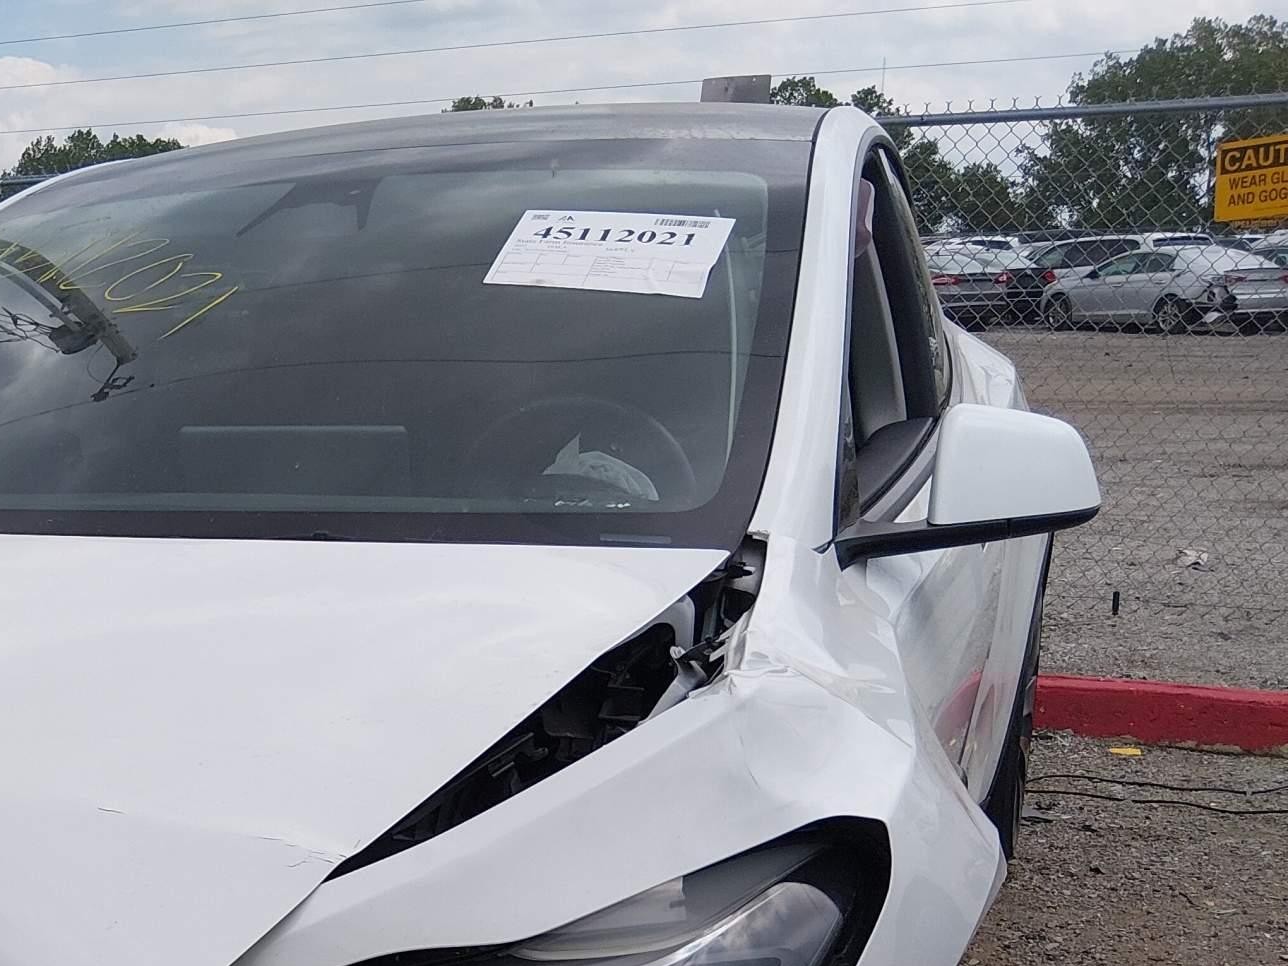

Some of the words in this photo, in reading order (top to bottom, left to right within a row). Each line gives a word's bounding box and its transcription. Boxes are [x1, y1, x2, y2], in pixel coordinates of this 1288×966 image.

[1228, 173, 1266, 190] WEAR
[1228, 192, 1254, 207] AND
[533, 226, 695, 246] 45112021
